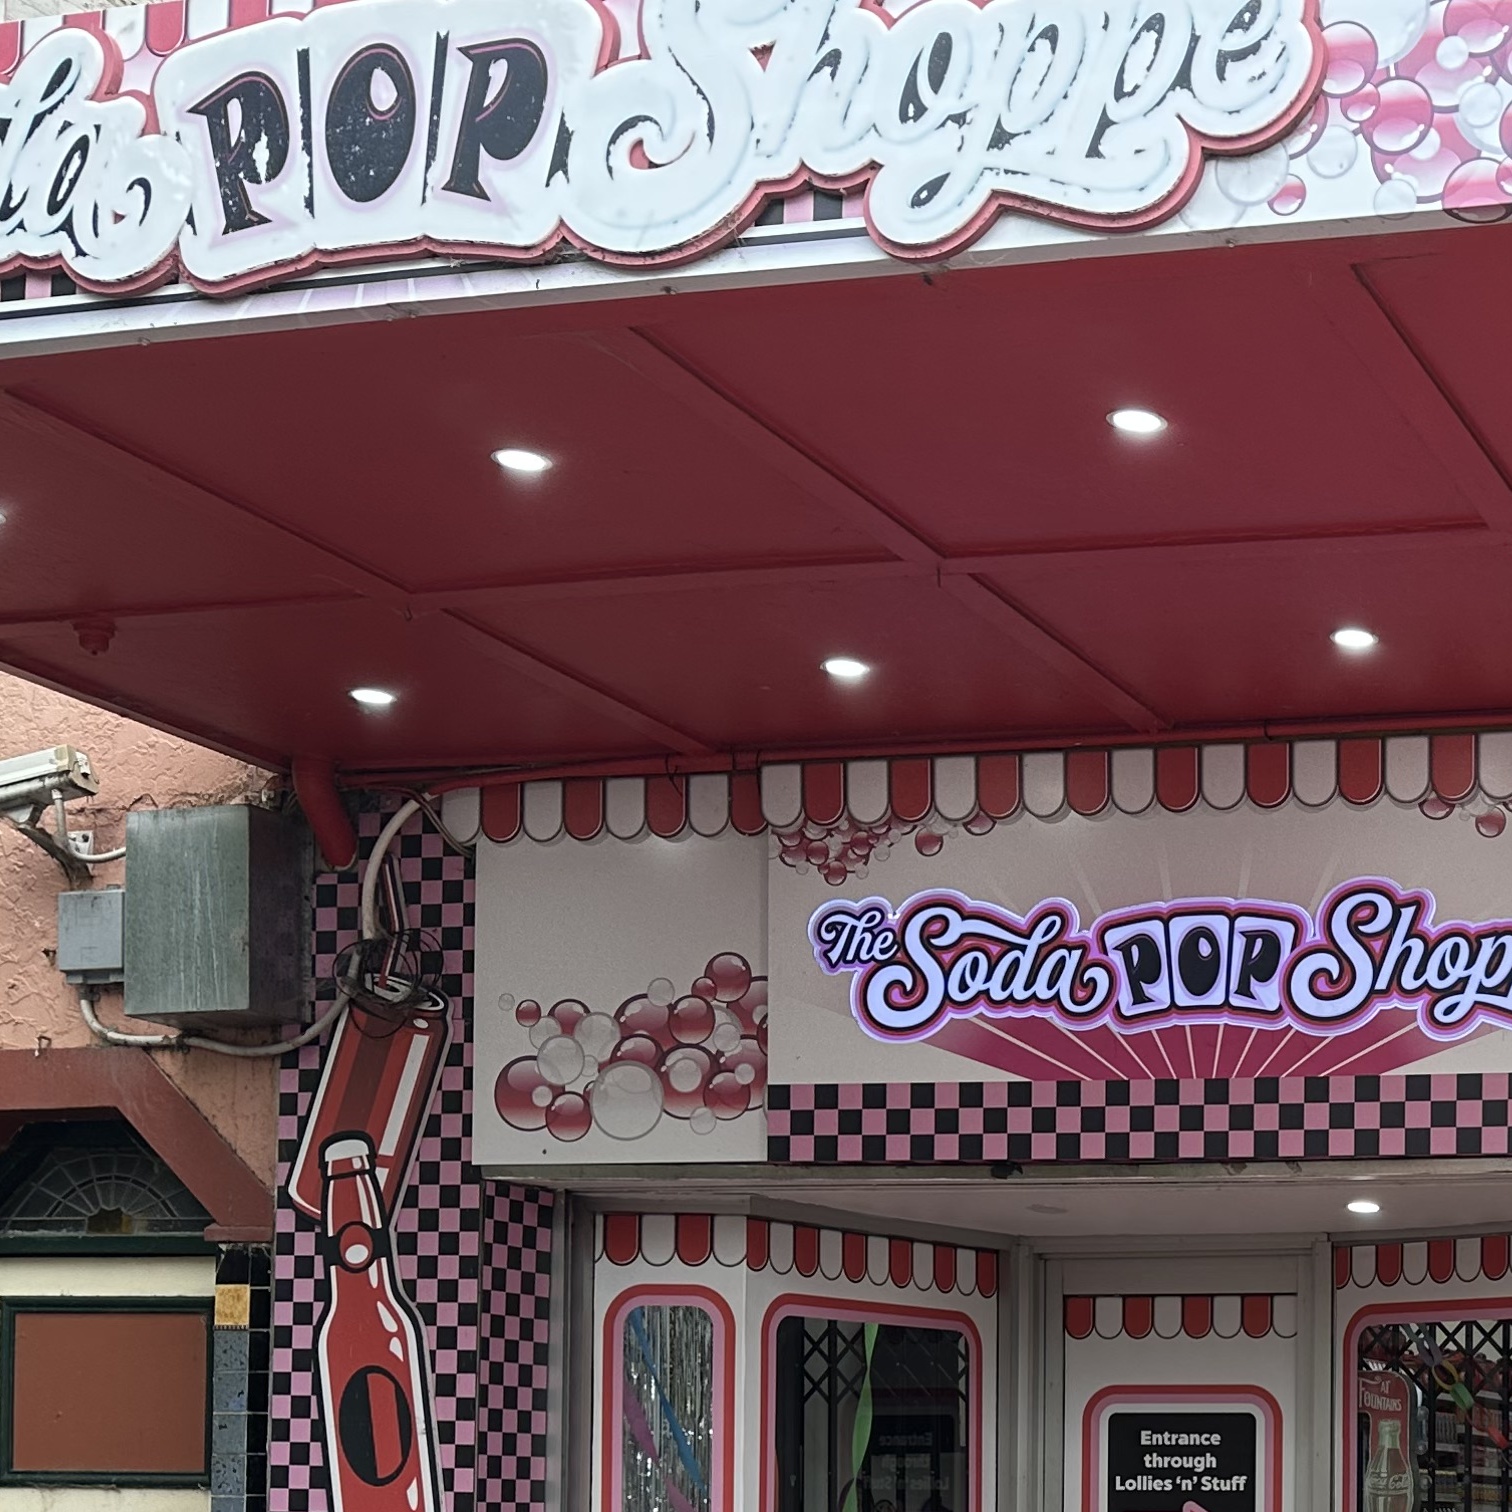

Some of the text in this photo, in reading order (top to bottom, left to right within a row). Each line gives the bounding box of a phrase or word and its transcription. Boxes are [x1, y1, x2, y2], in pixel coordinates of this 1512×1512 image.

[187, 37, 549, 237] POP
[568, 0, 1294, 234] Shoppe
[819, 908, 898, 966] The
[866, 906, 1109, 1029] Soda
[1106, 925, 1287, 1003] POP
[1358, 1376, 1402, 1411] FOUNTAINS
[1140, 1430, 1222, 1446] Entrance
[1143, 1452, 1217, 1472] through
[1115, 1475, 1173, 1491] Lollies
[1200, 1475, 1248, 1491] Stuff
